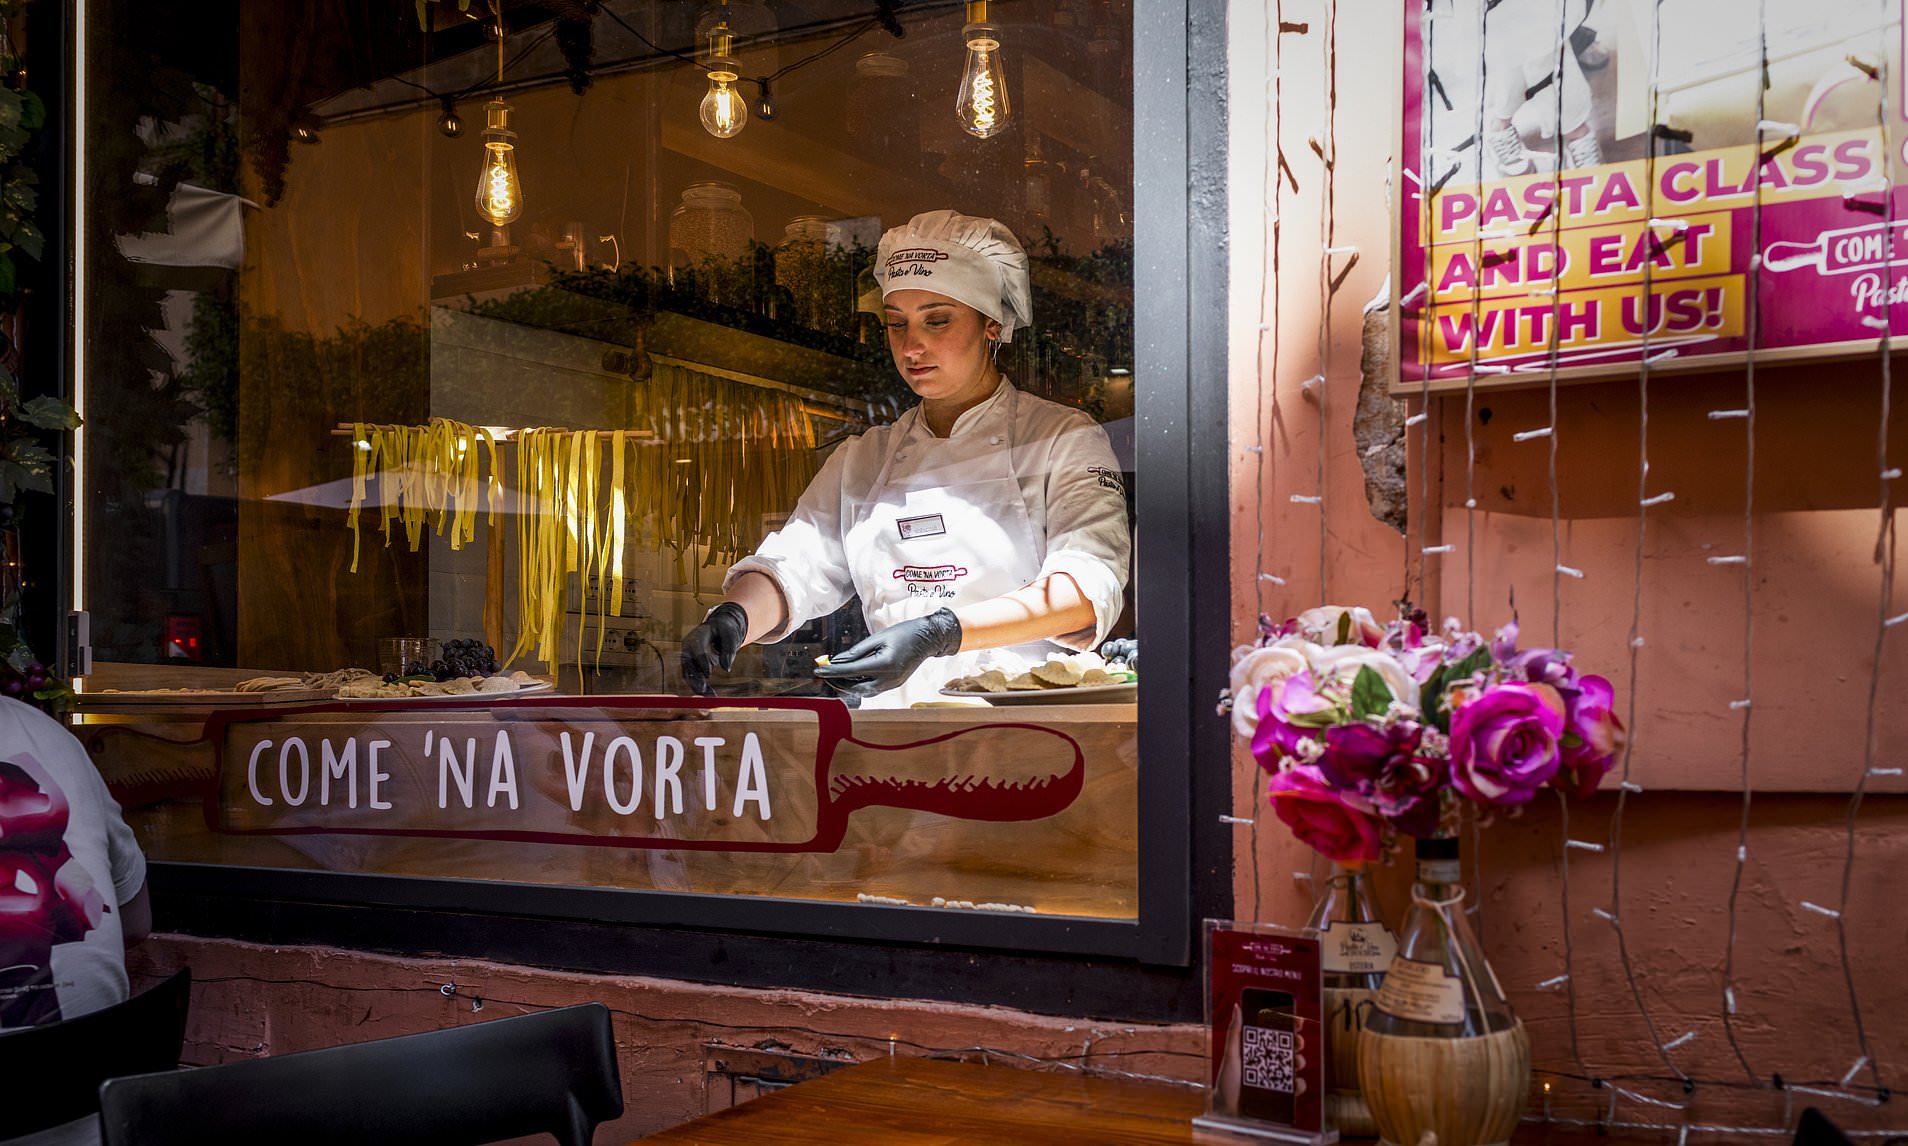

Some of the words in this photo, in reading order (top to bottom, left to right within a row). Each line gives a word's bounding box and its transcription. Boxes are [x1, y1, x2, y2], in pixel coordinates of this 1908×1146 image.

[1440, 171, 1641, 233] PASTA
[1660, 138, 1872, 201] CLASS
[910, 263, 933, 276] Vino
[1437, 244, 1570, 295] AND
[1588, 224, 1716, 278] EAT
[1851, 273, 1908, 312] Past
[1438, 300, 1602, 353] WITH
[1620, 287, 1725, 335] US!
[905, 569, 922, 578] COME
[247, 735, 393, 810] COME
[424, 729, 521, 810] 'NA
[560, 730, 773, 821] VORTA
